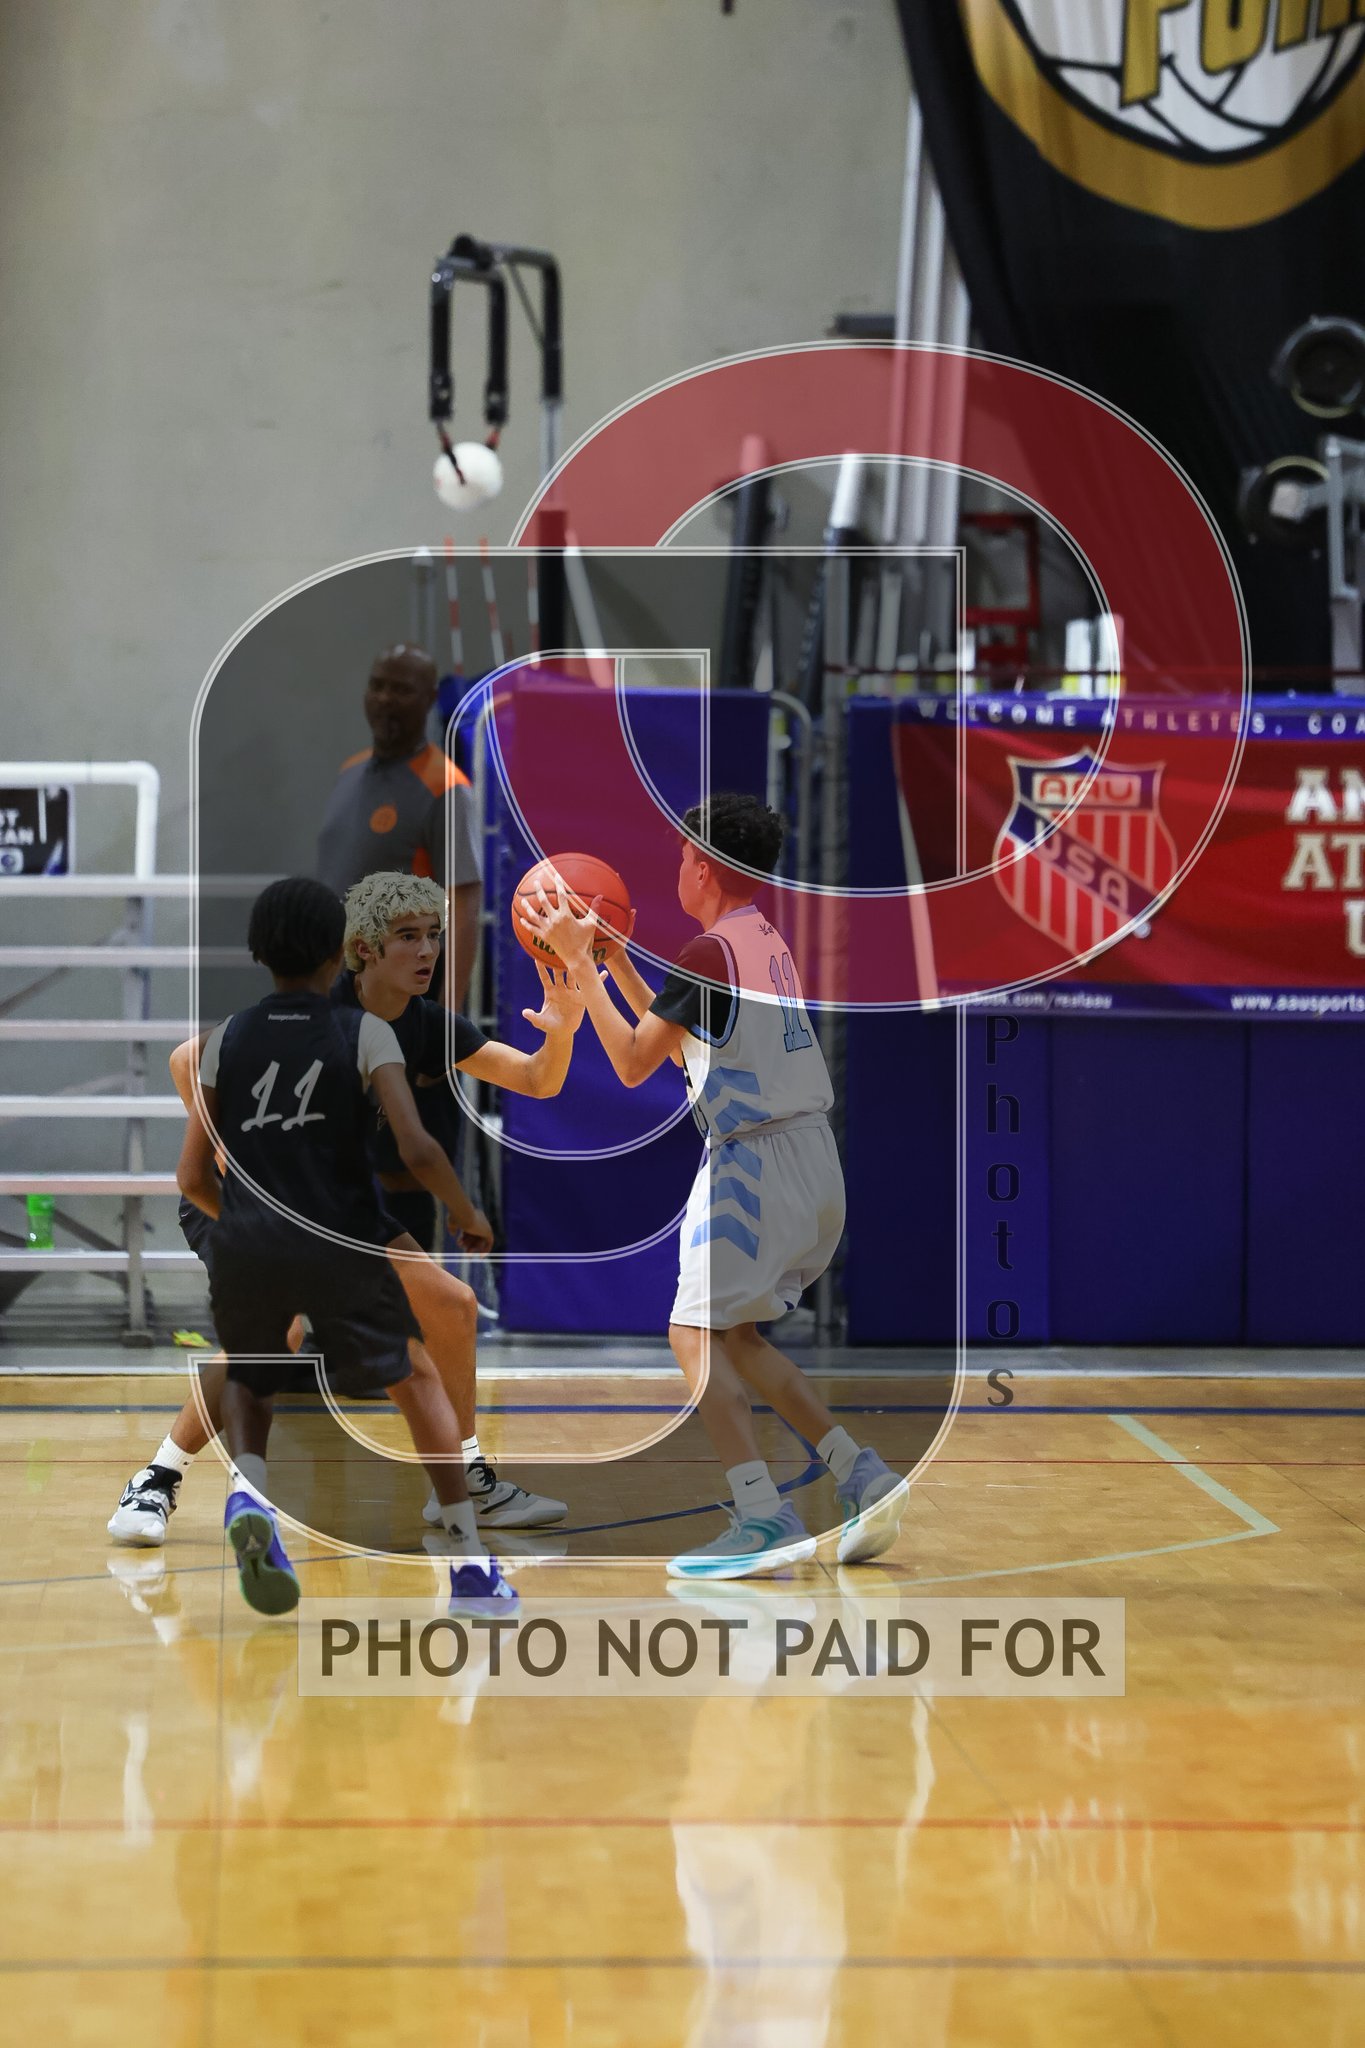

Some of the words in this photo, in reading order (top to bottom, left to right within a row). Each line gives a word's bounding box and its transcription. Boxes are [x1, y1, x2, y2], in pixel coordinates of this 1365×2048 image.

[917, 698, 1077, 727] WELCOME
[1040, 776, 1132, 800] AAU
[1034, 817, 1128, 914] USA
[769, 952, 812, 1053] 11
[240, 1059, 326, 1133] 11
